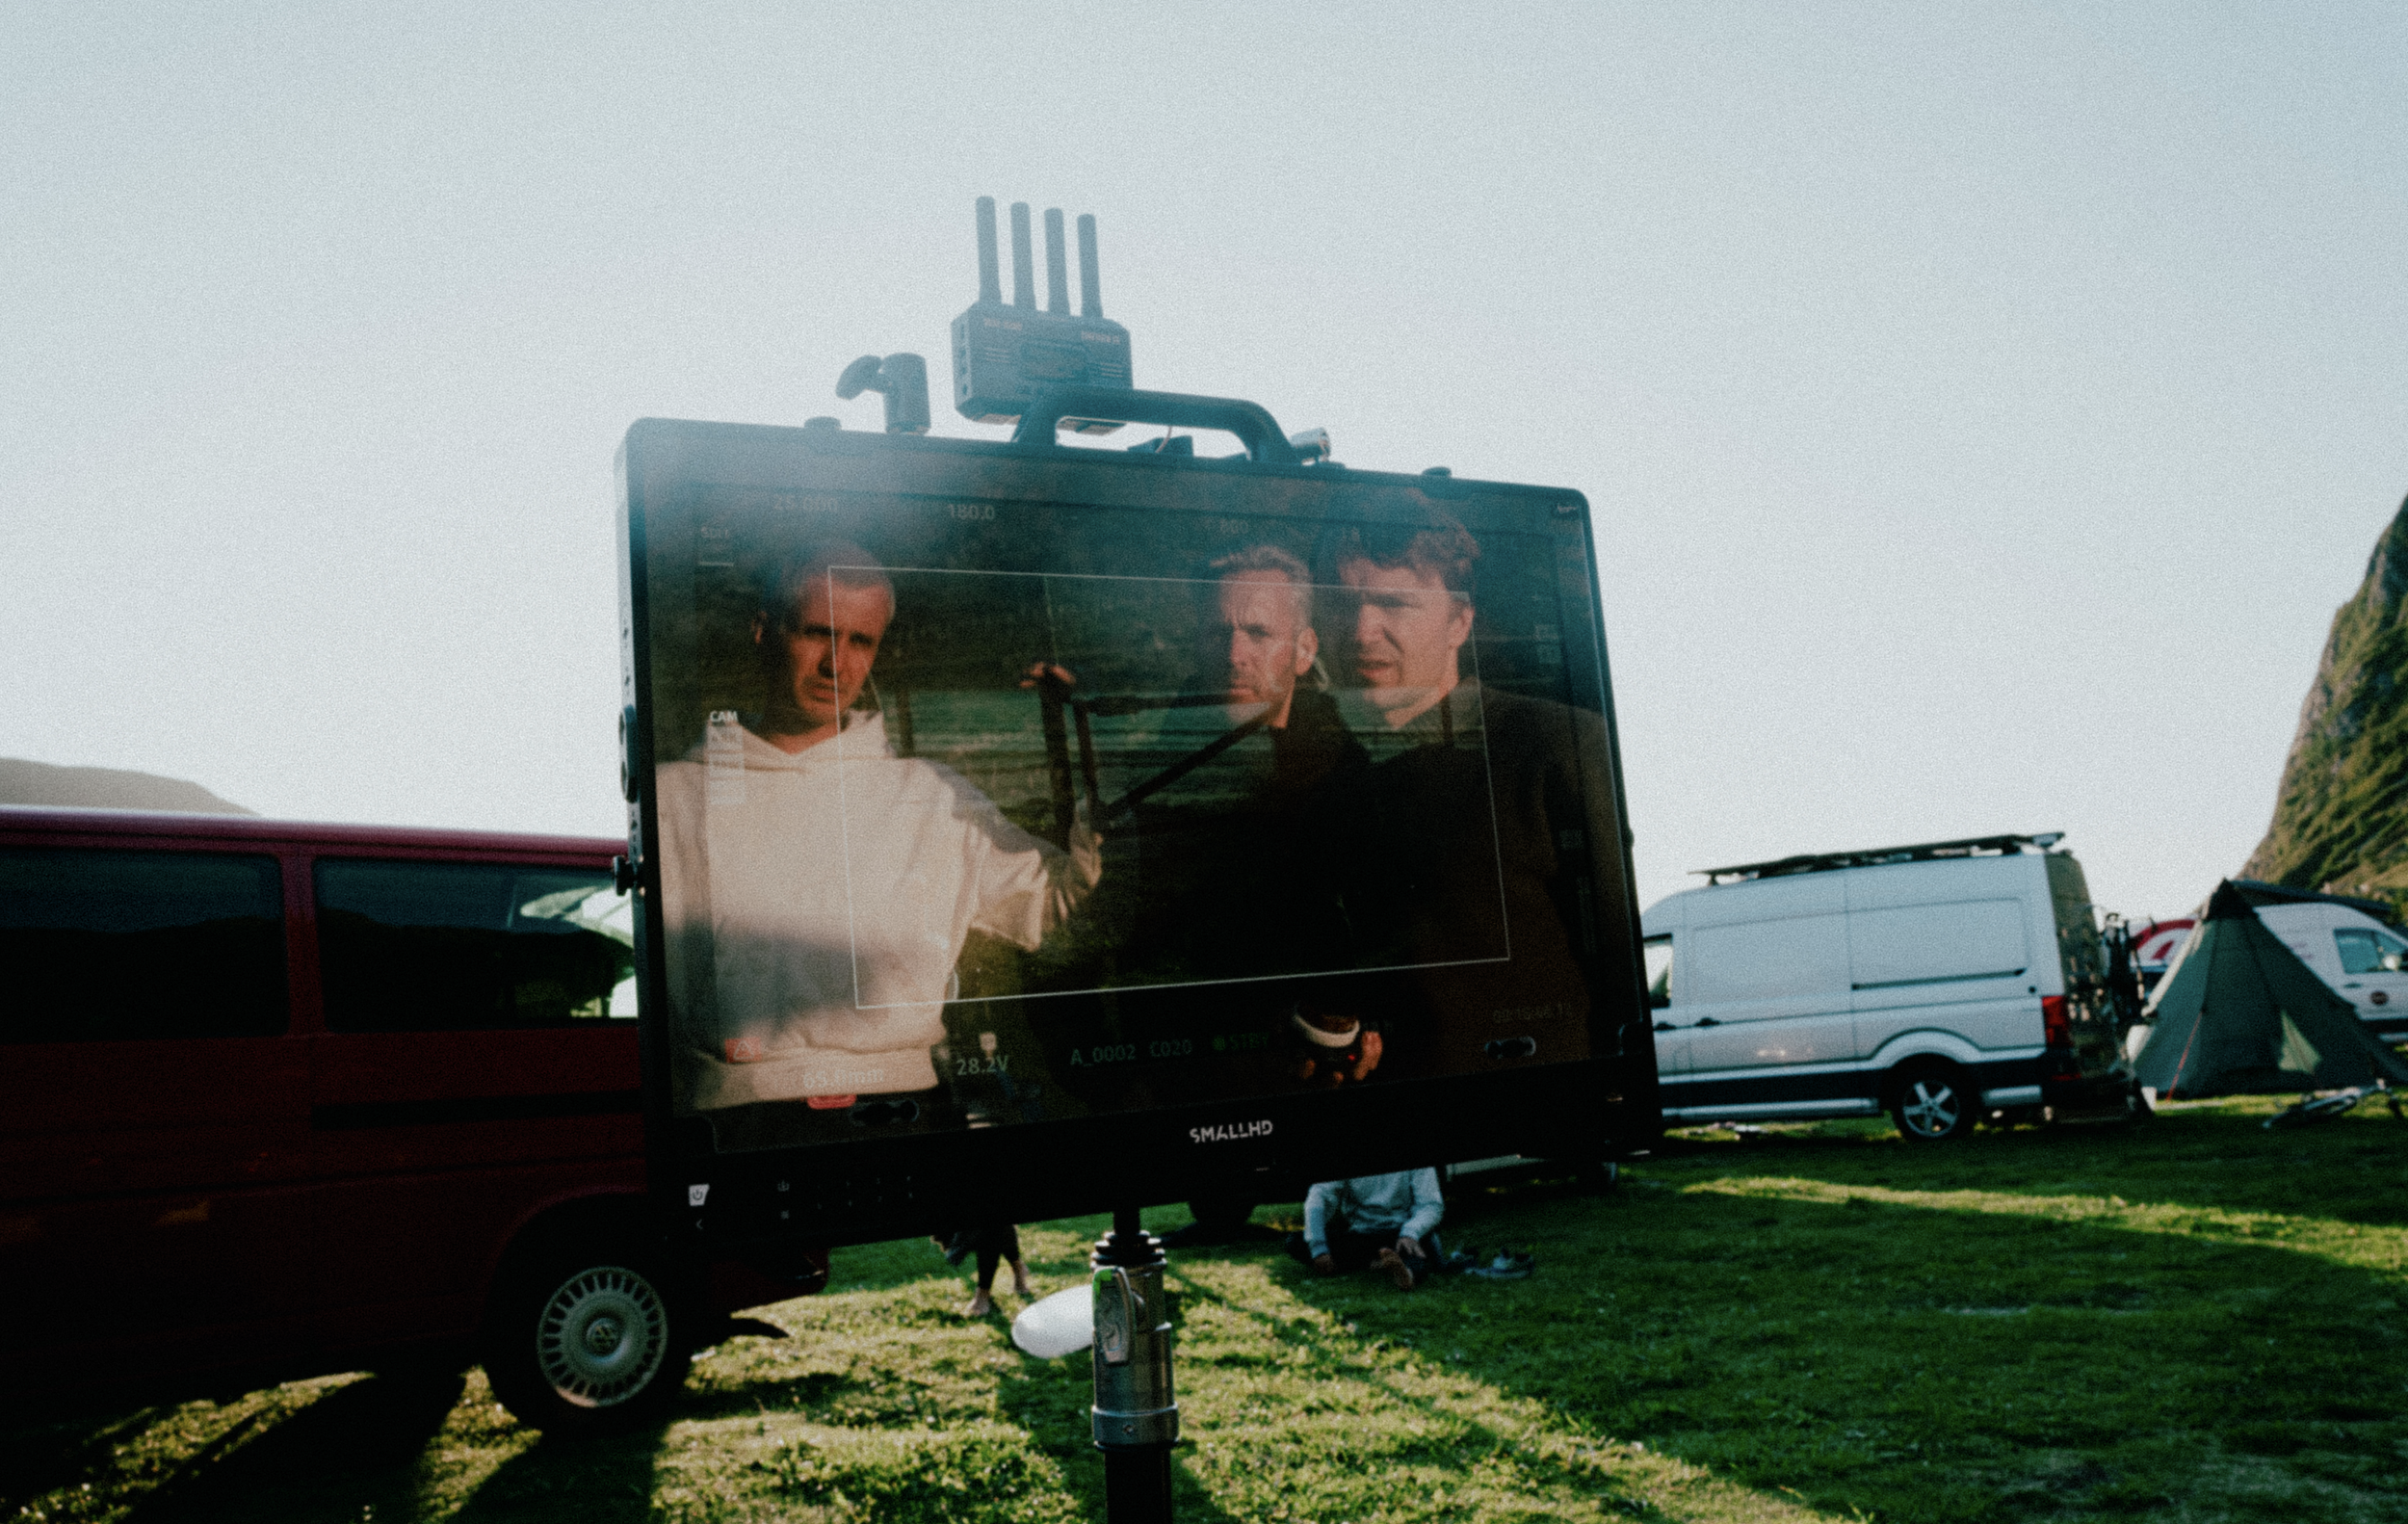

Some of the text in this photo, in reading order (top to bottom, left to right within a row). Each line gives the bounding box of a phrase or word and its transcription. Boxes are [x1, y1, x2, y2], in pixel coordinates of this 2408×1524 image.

[948, 502, 996, 521] 180.0
[709, 710, 738, 723] CAM
[1070, 1038, 1192, 1067] A_0002 C020
[956, 1055, 1008, 1076] 28.2V
[1190, 1119, 1273, 1143] SMALLHD
